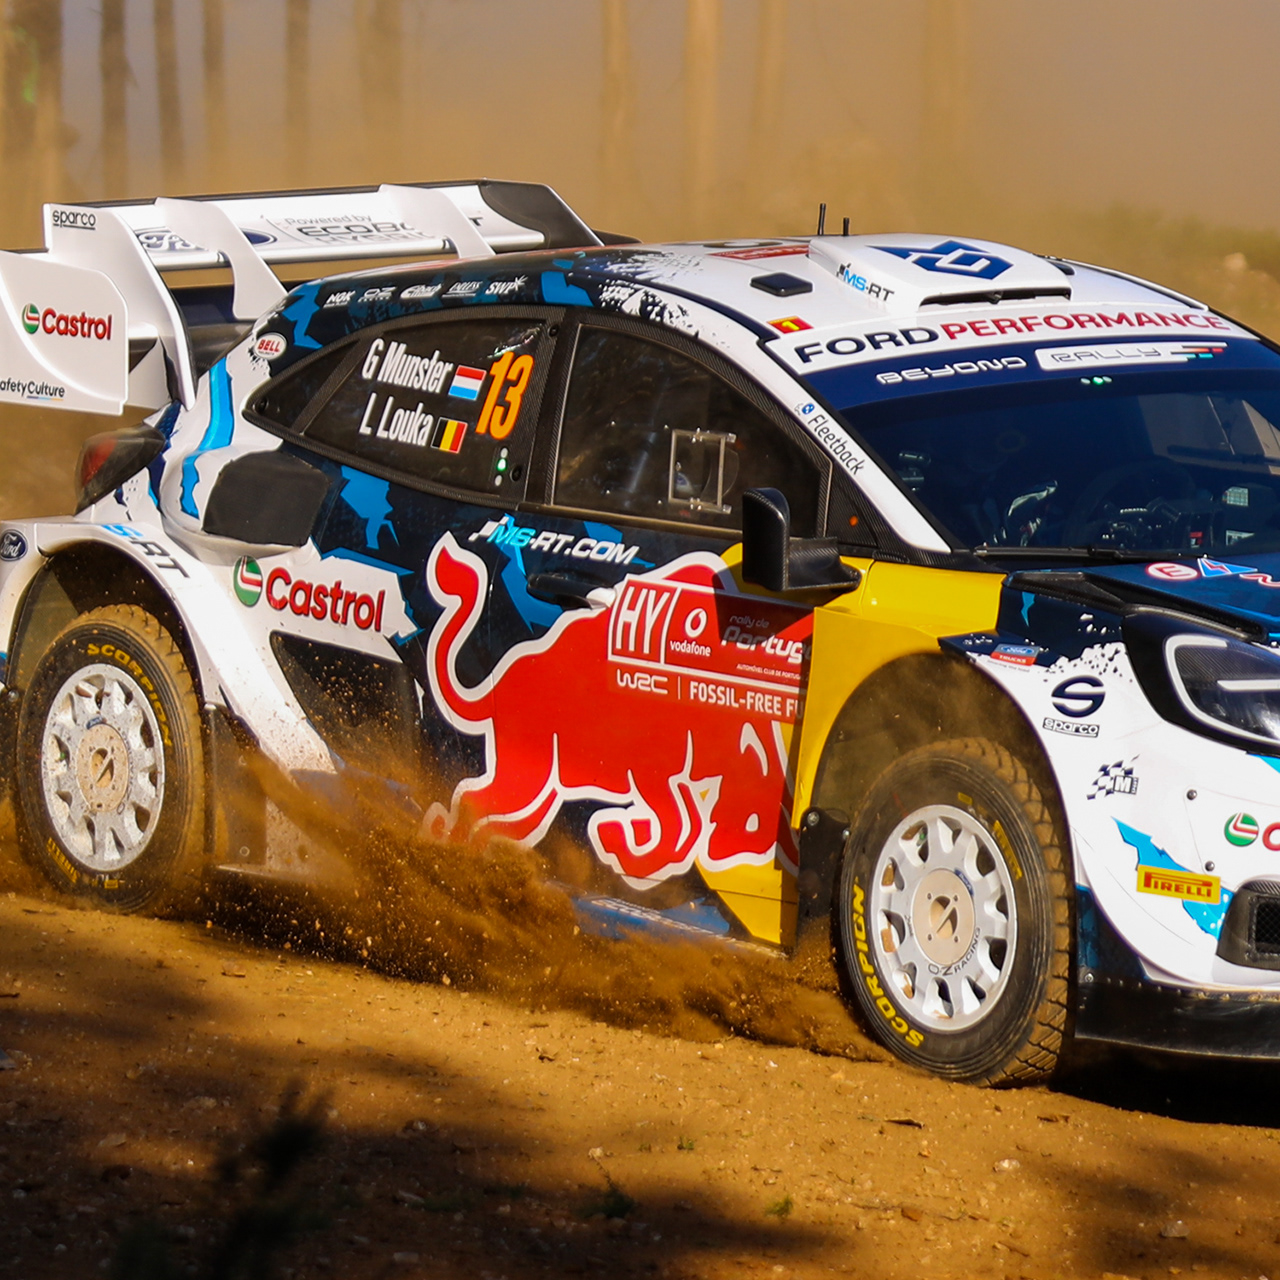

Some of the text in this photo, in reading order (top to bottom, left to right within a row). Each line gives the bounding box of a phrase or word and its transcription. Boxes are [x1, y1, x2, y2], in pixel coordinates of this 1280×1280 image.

[52, 209, 96, 228] sparco
[284, 215, 354, 226] Powered
[328, 290, 356, 302] NGK
[485, 281, 516, 295] SWP
[42, 307, 113, 341] Castrol
[781, 320, 801, 331] 1
[258, 339, 280, 352] BELL
[361, 337, 455, 394] G Munster
[876, 347, 1162, 385] BEYOND RALLY
[475, 351, 535, 440] 13
[359, 392, 434, 447] L Louka
[808, 415, 865, 475] Fleetback
[266, 567, 386, 632] Castrol
[615, 586, 671, 655] HY
[729, 615, 769, 628] rally de
[669, 640, 711, 658] vodafone
[617, 668, 668, 695] WRC
[690, 681, 805, 720] FOSSIL-FREE FU
[1044, 719, 1098, 737] sparco
[1143, 871, 1214, 899] PIRELLI
[853, 883, 924, 1047] SCORPION
[954, 926, 981, 974] RACING
